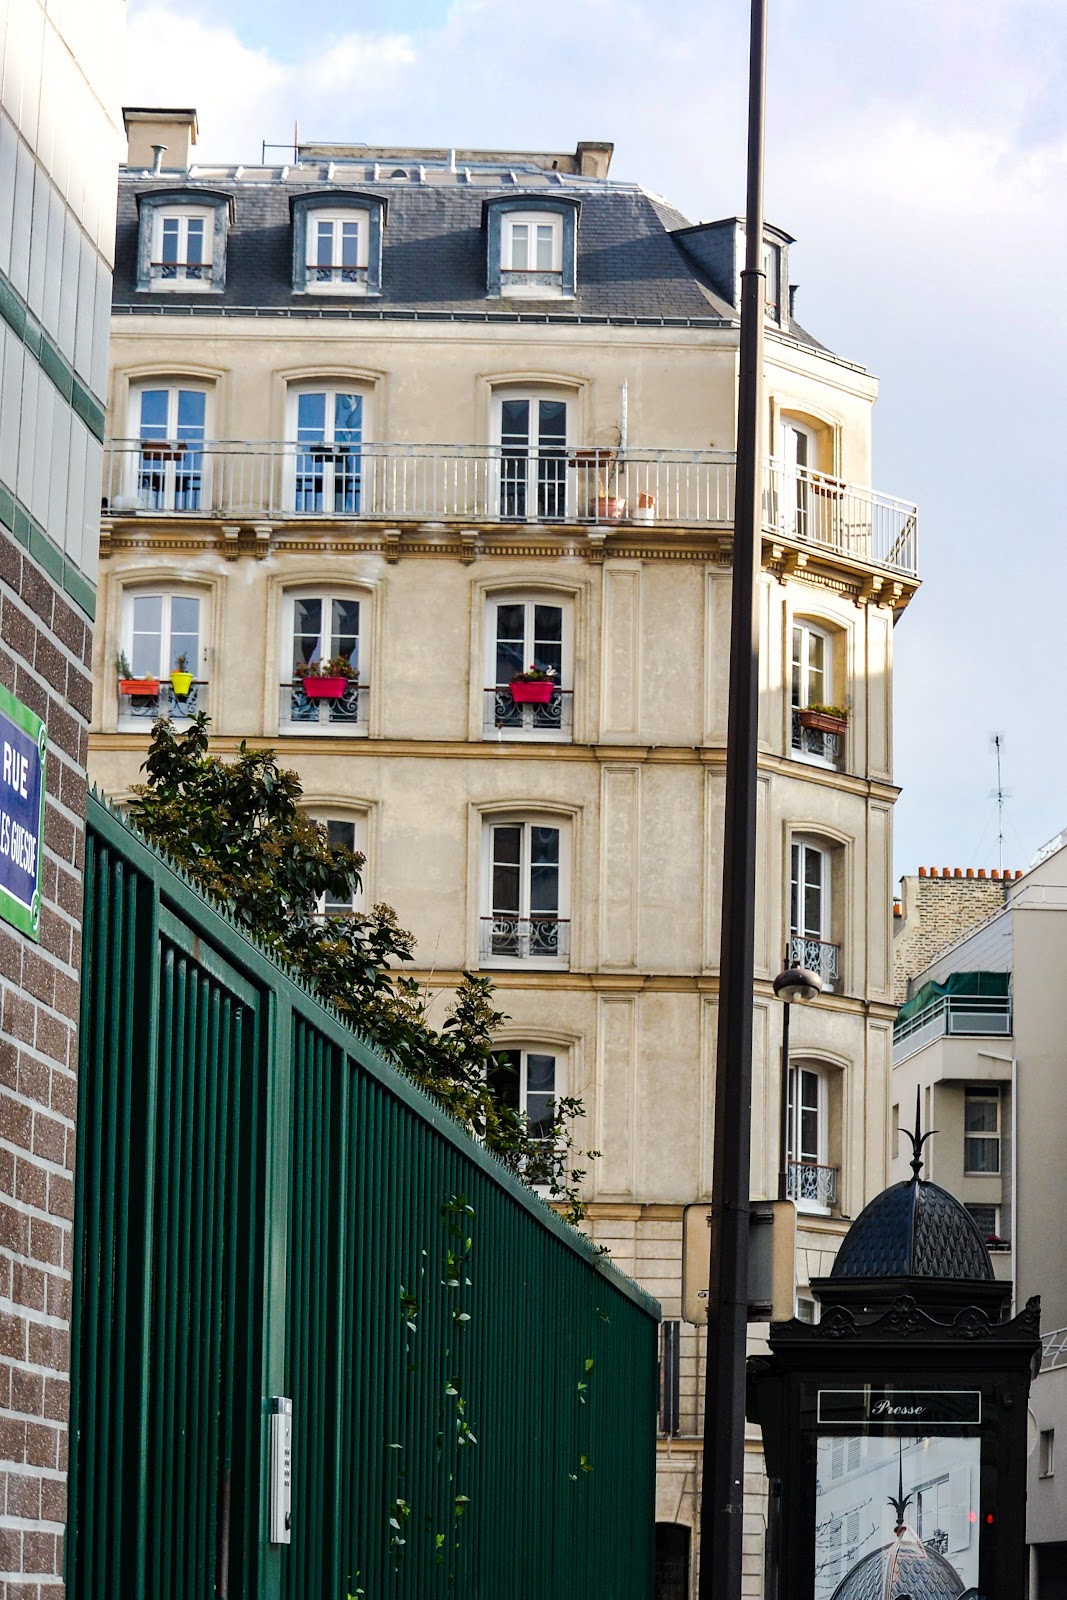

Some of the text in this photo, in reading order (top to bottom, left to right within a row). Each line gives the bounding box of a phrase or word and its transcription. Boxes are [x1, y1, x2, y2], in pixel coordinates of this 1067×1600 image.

[3, 741, 28, 799] RUE
[11, 820, 36, 878] GUESDE
[871, 1399, 926, 1415] Presse
